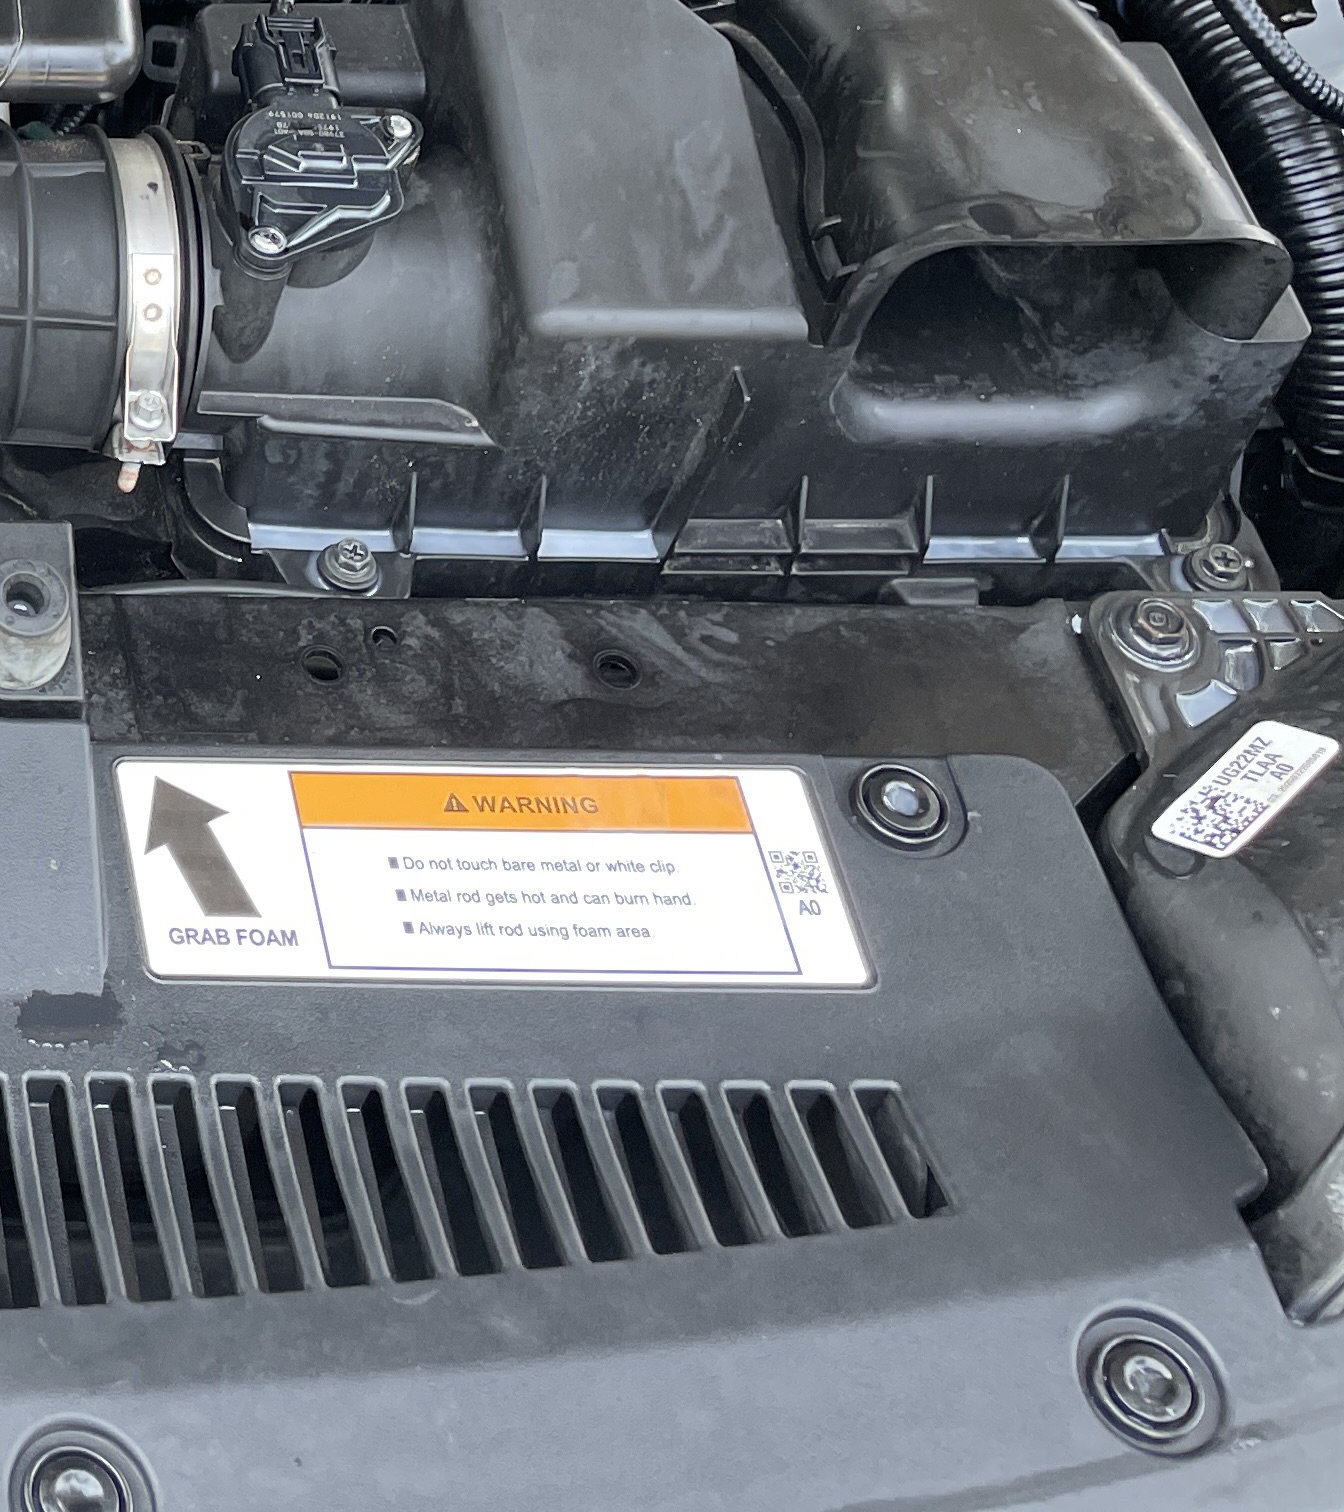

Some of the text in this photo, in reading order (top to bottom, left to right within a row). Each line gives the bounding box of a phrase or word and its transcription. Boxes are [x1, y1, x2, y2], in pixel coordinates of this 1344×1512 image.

[1240, 753, 1283, 783] TLAA
[472, 795, 599, 814] WARNING
[403, 857, 424, 871] Do
[429, 858, 452, 871] not
[456, 858, 497, 871] touch
[503, 858, 535, 872] bare
[541, 859, 582, 873] metal
[586, 863, 600, 873] or
[606, 859, 645, 873] white
[410, 889, 696, 906] Metal rod gets hot and can burn hand.
[169, 927, 299, 946] GRAB FOAM
[419, 922, 472, 939] Always
[476, 922, 496, 936] lift
[499, 923, 524, 937] rod
[527, 924, 569, 940] using
[572, 924, 612, 938] foam
